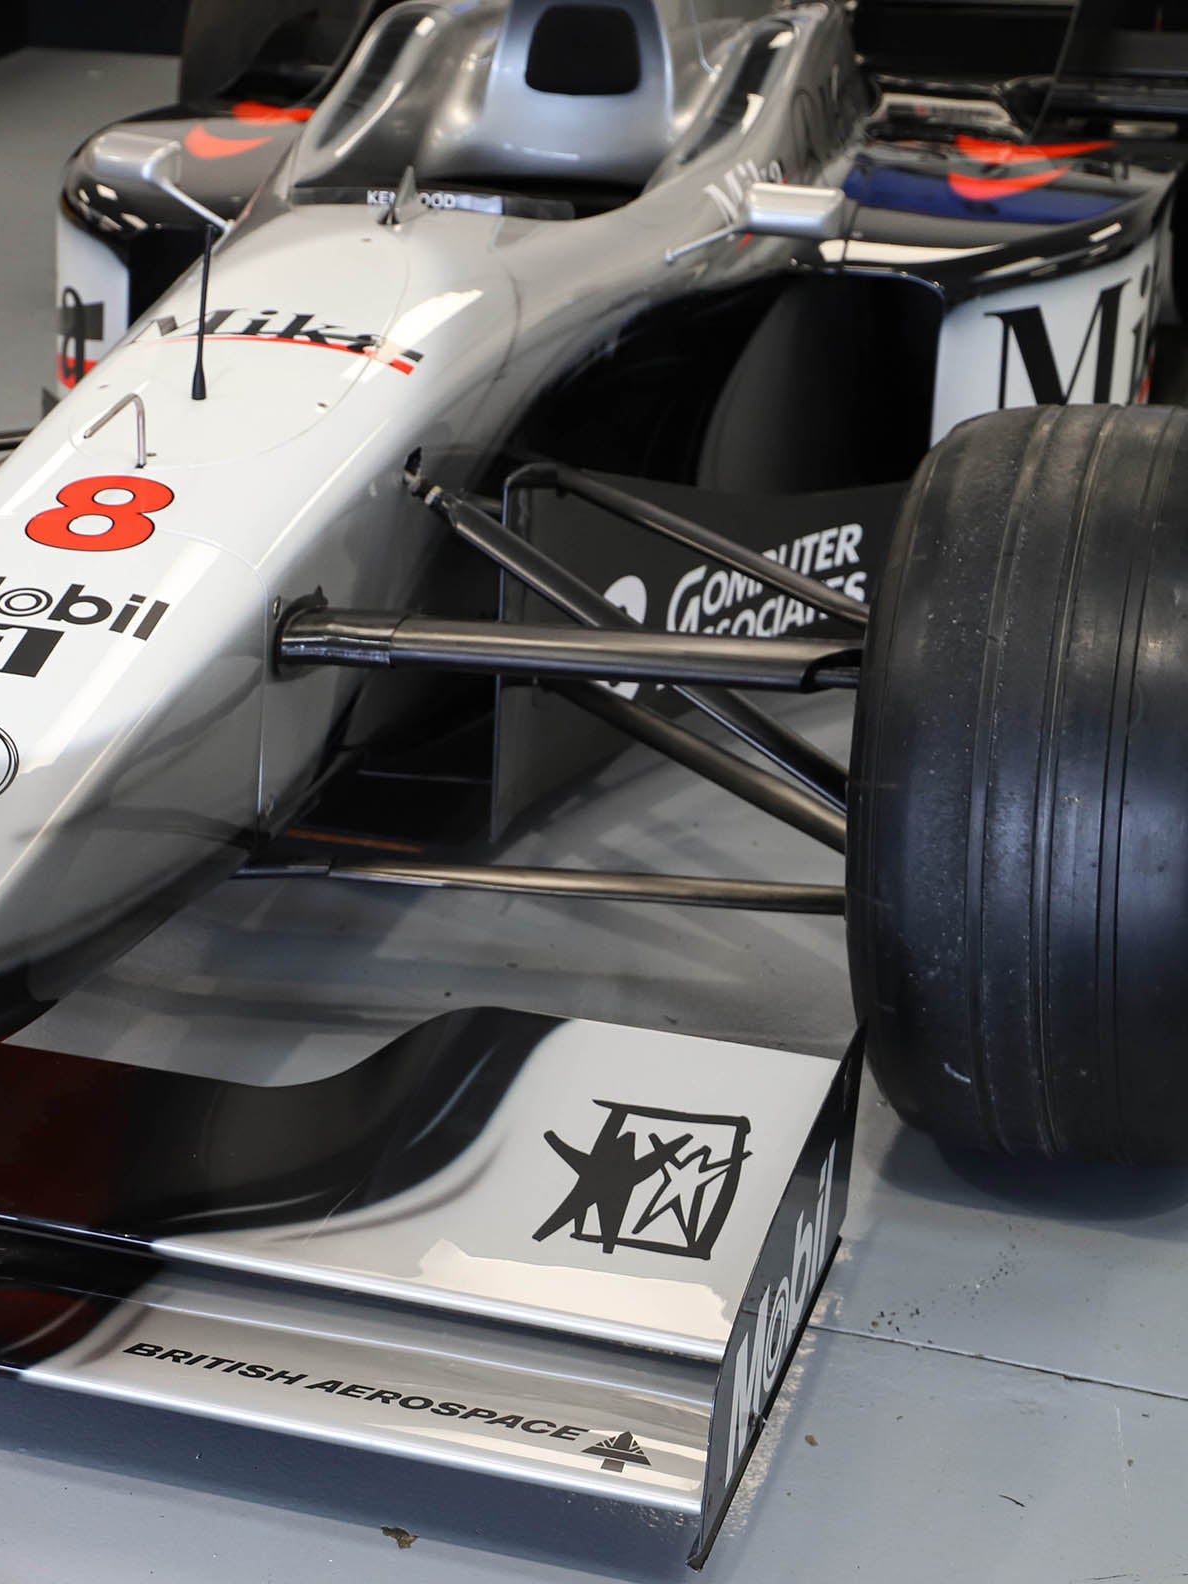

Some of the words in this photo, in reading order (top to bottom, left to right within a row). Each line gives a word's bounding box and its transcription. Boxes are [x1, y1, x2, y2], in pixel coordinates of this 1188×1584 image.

[366, 190, 457, 211] KENOOD
[25, 475, 175, 552] 8
[678, 571, 868, 638] AOCIAS
[725, 1138, 836, 1488] Mobil
[122, 1342, 309, 1385] BRITISH
[304, 1379, 590, 1442] AEROSPACE
